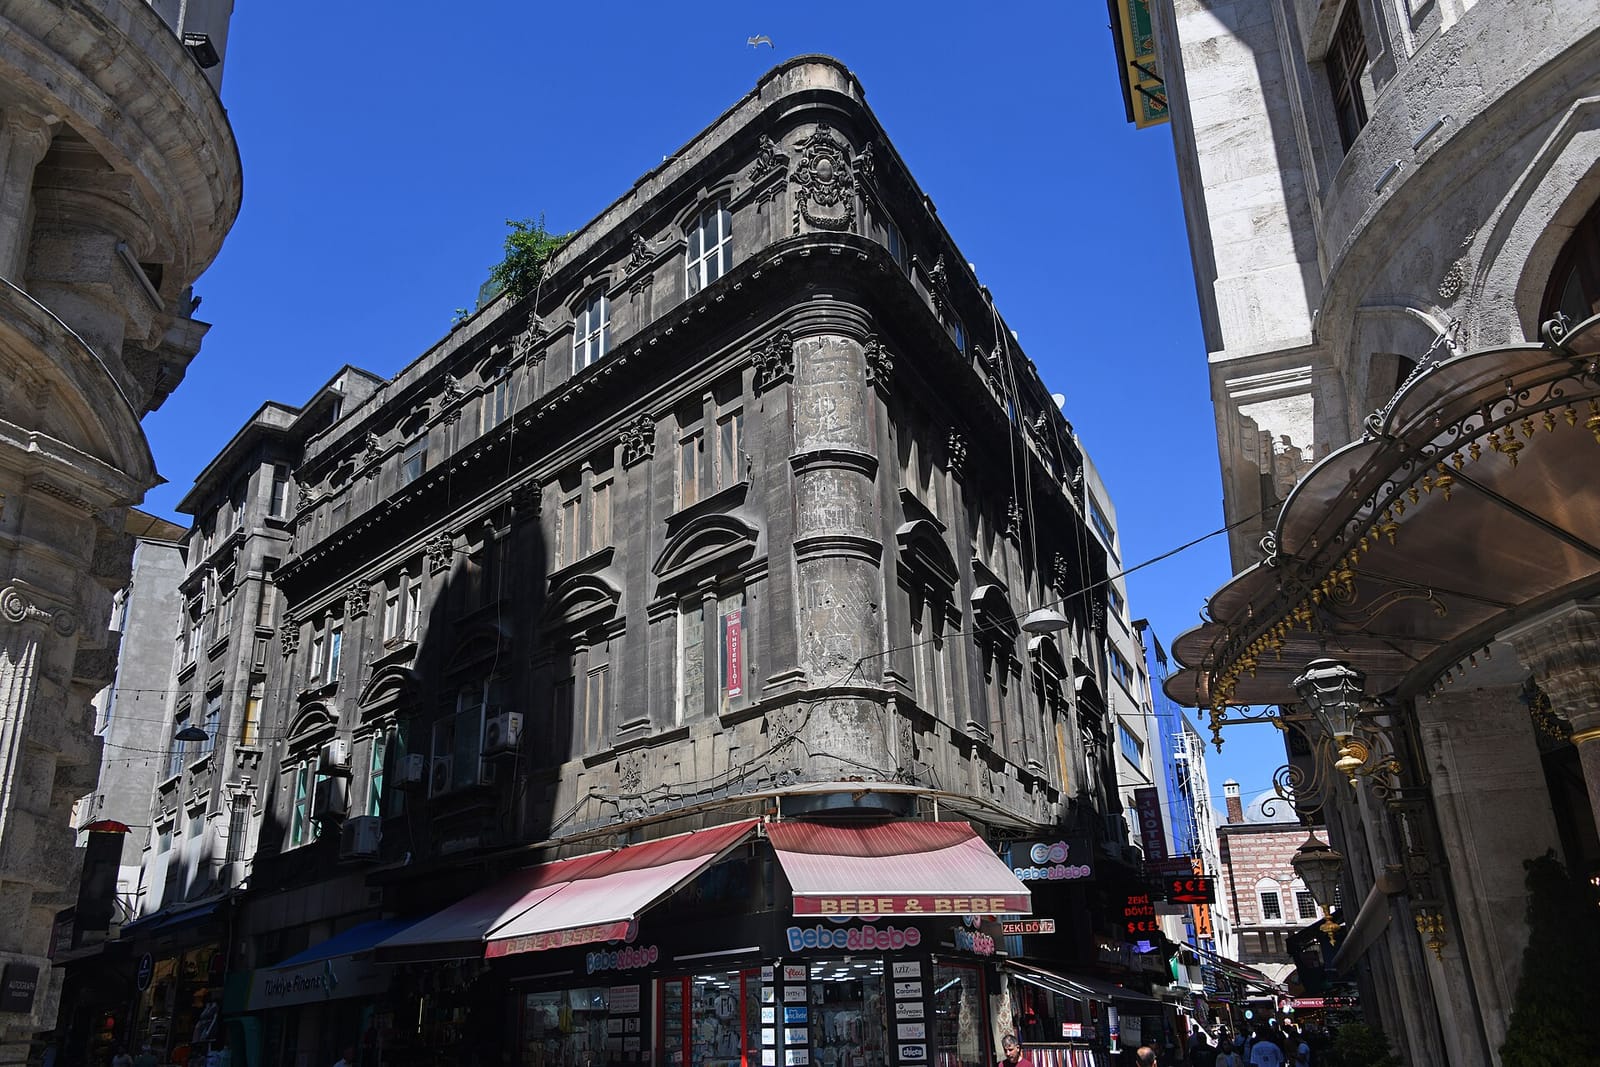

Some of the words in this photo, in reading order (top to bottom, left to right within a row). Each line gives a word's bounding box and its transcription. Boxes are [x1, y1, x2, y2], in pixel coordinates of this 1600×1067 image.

[1143, 809, 1162, 859] NOTER
[1014, 864, 1090, 881] Bebe&Bebe
[820, 898, 894, 914] BEBE
[904, 898, 924, 914] &
[934, 897, 1006, 913] BEBE
[1003, 922, 1024, 933] ZEKİ
[1025, 921, 1054, 932] DÖVİZ
[506, 935, 544, 953] BEBE
[787, 924, 921, 952] Bebe&Bebe
[586, 945, 658, 974] Bebe&Bebe
[265, 978, 291, 997] Türkiye
[294, 975, 320, 990] Finans
